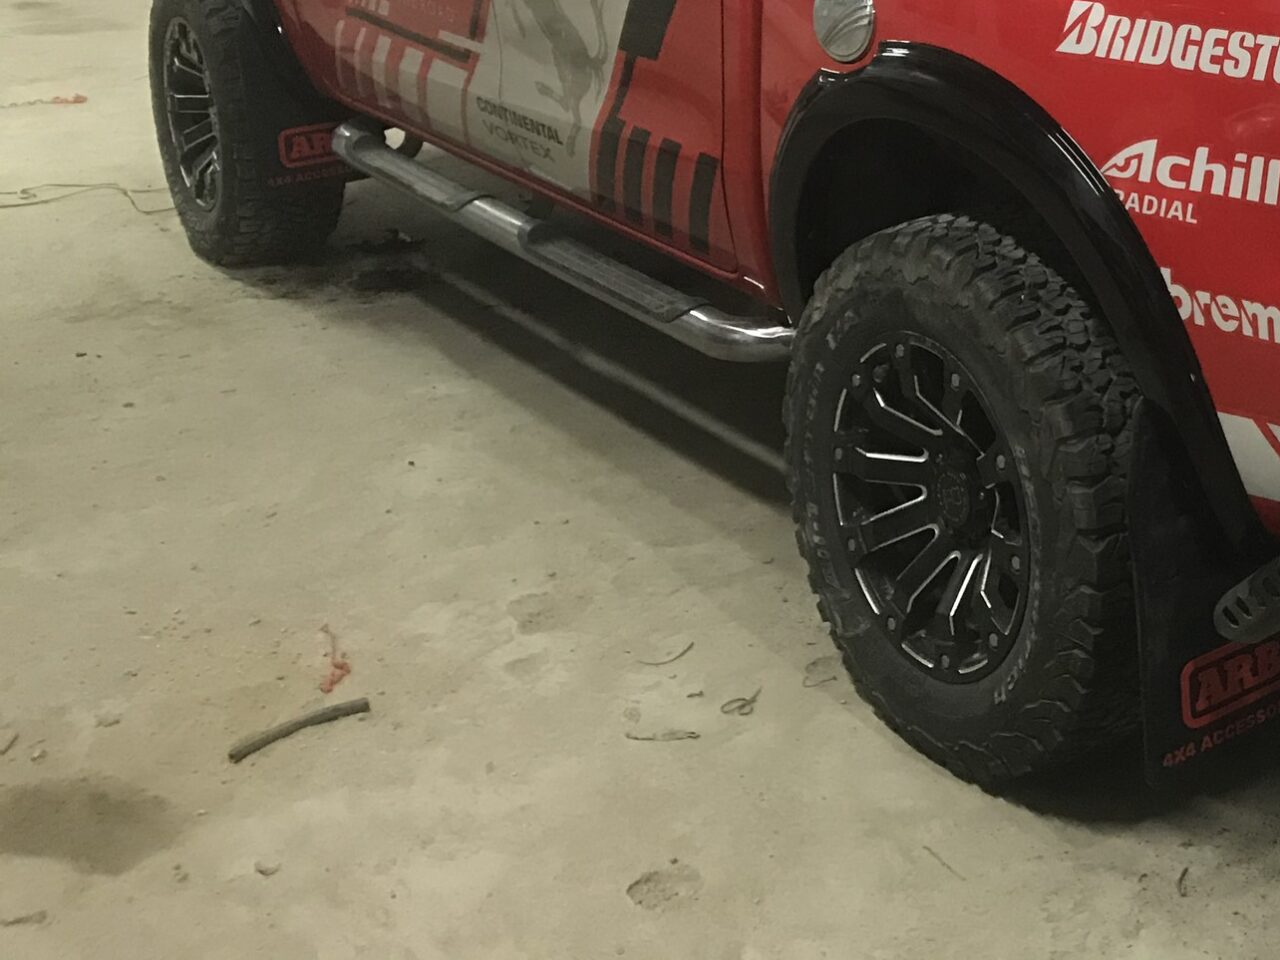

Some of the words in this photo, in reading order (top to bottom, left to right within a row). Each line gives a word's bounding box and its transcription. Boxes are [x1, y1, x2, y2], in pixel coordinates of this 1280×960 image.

[476, 96, 564, 146] CONTINENTAL
[482, 119, 556, 163] VORTEX
[288, 132, 333, 160] AR
